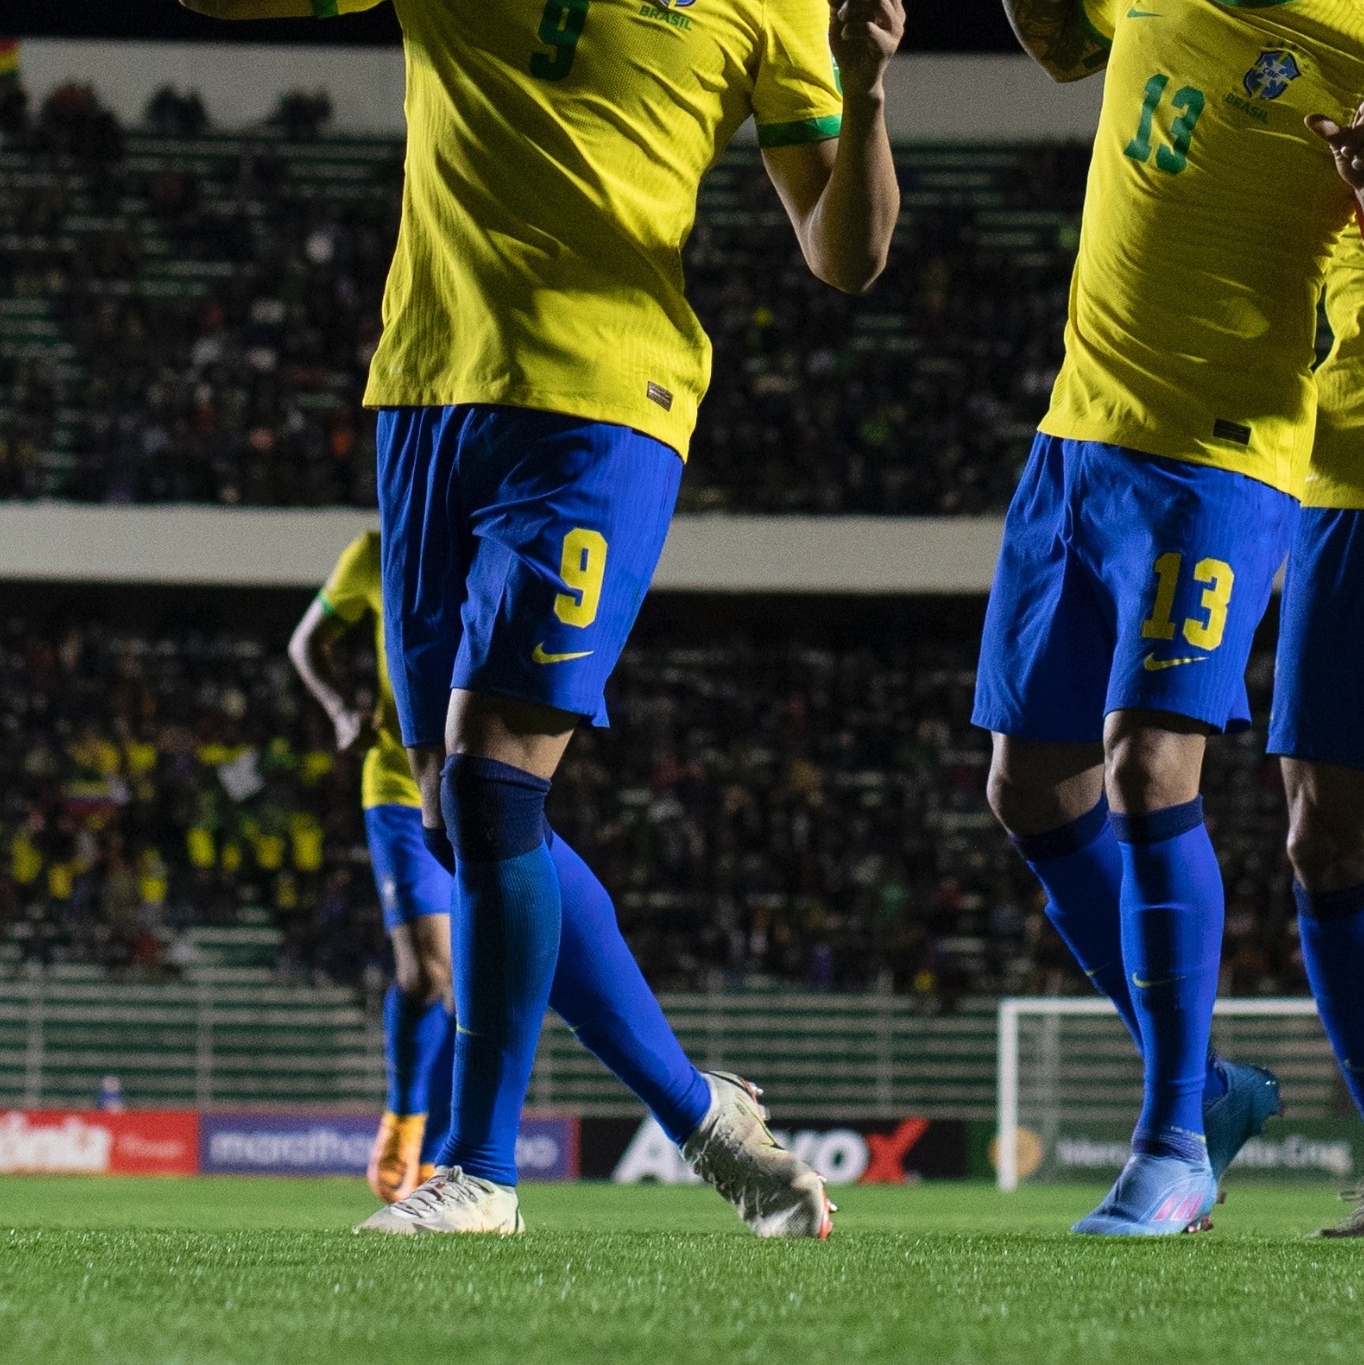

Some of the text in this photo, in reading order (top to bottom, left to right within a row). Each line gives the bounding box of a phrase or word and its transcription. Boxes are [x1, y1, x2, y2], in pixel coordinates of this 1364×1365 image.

[639, 4, 692, 32] BRASIL
[1123, 73, 1205, 175] 13
[553, 527, 609, 629] 9
[1142, 552, 1235, 651] 13
